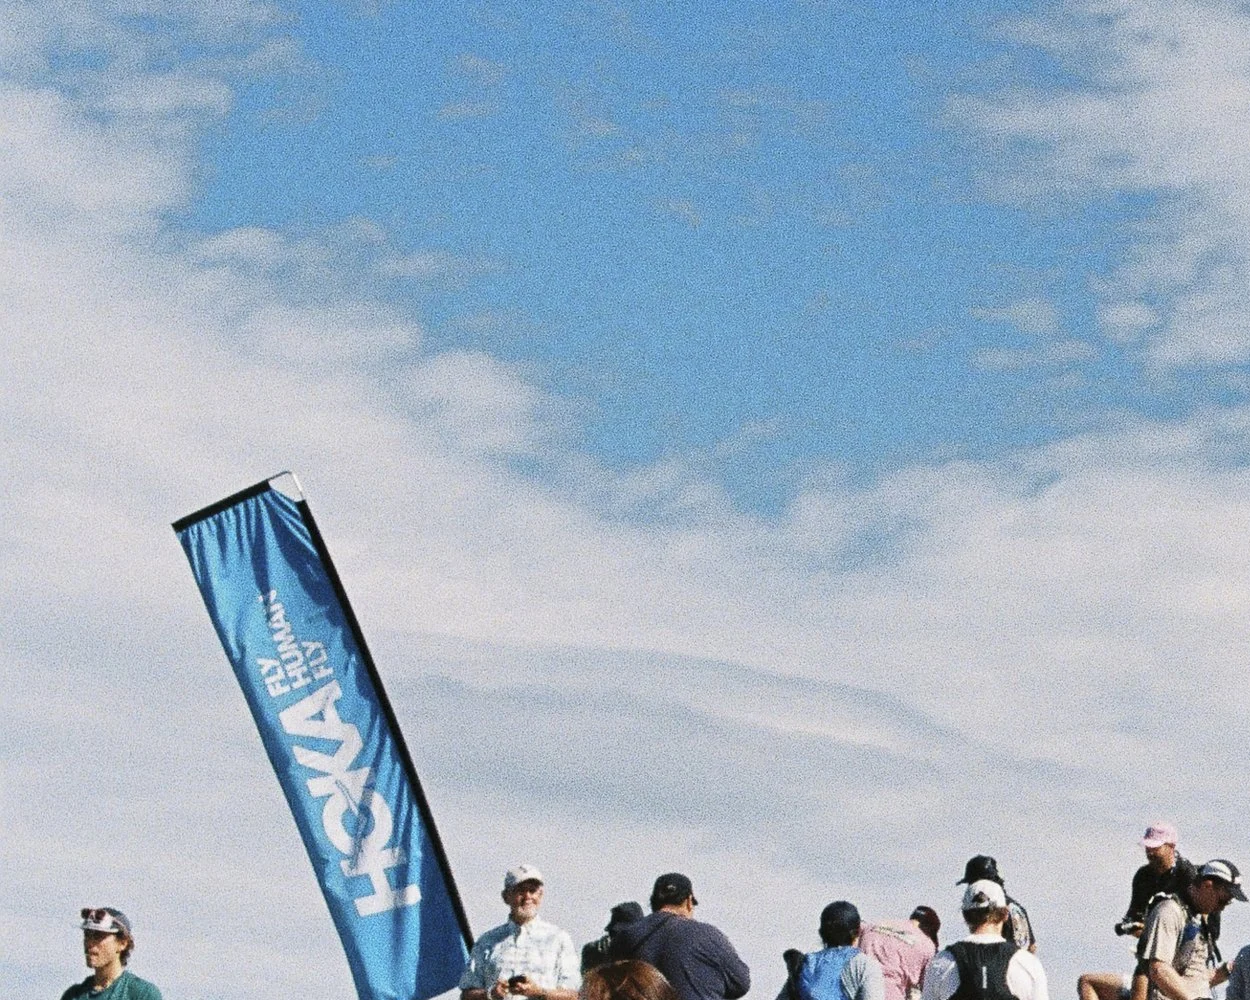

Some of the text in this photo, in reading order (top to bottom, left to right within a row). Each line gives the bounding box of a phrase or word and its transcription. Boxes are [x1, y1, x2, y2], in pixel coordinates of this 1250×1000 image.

[257, 658, 291, 697] FLY
[301, 641, 334, 680] FLY
[279, 679, 422, 918] HOKA
